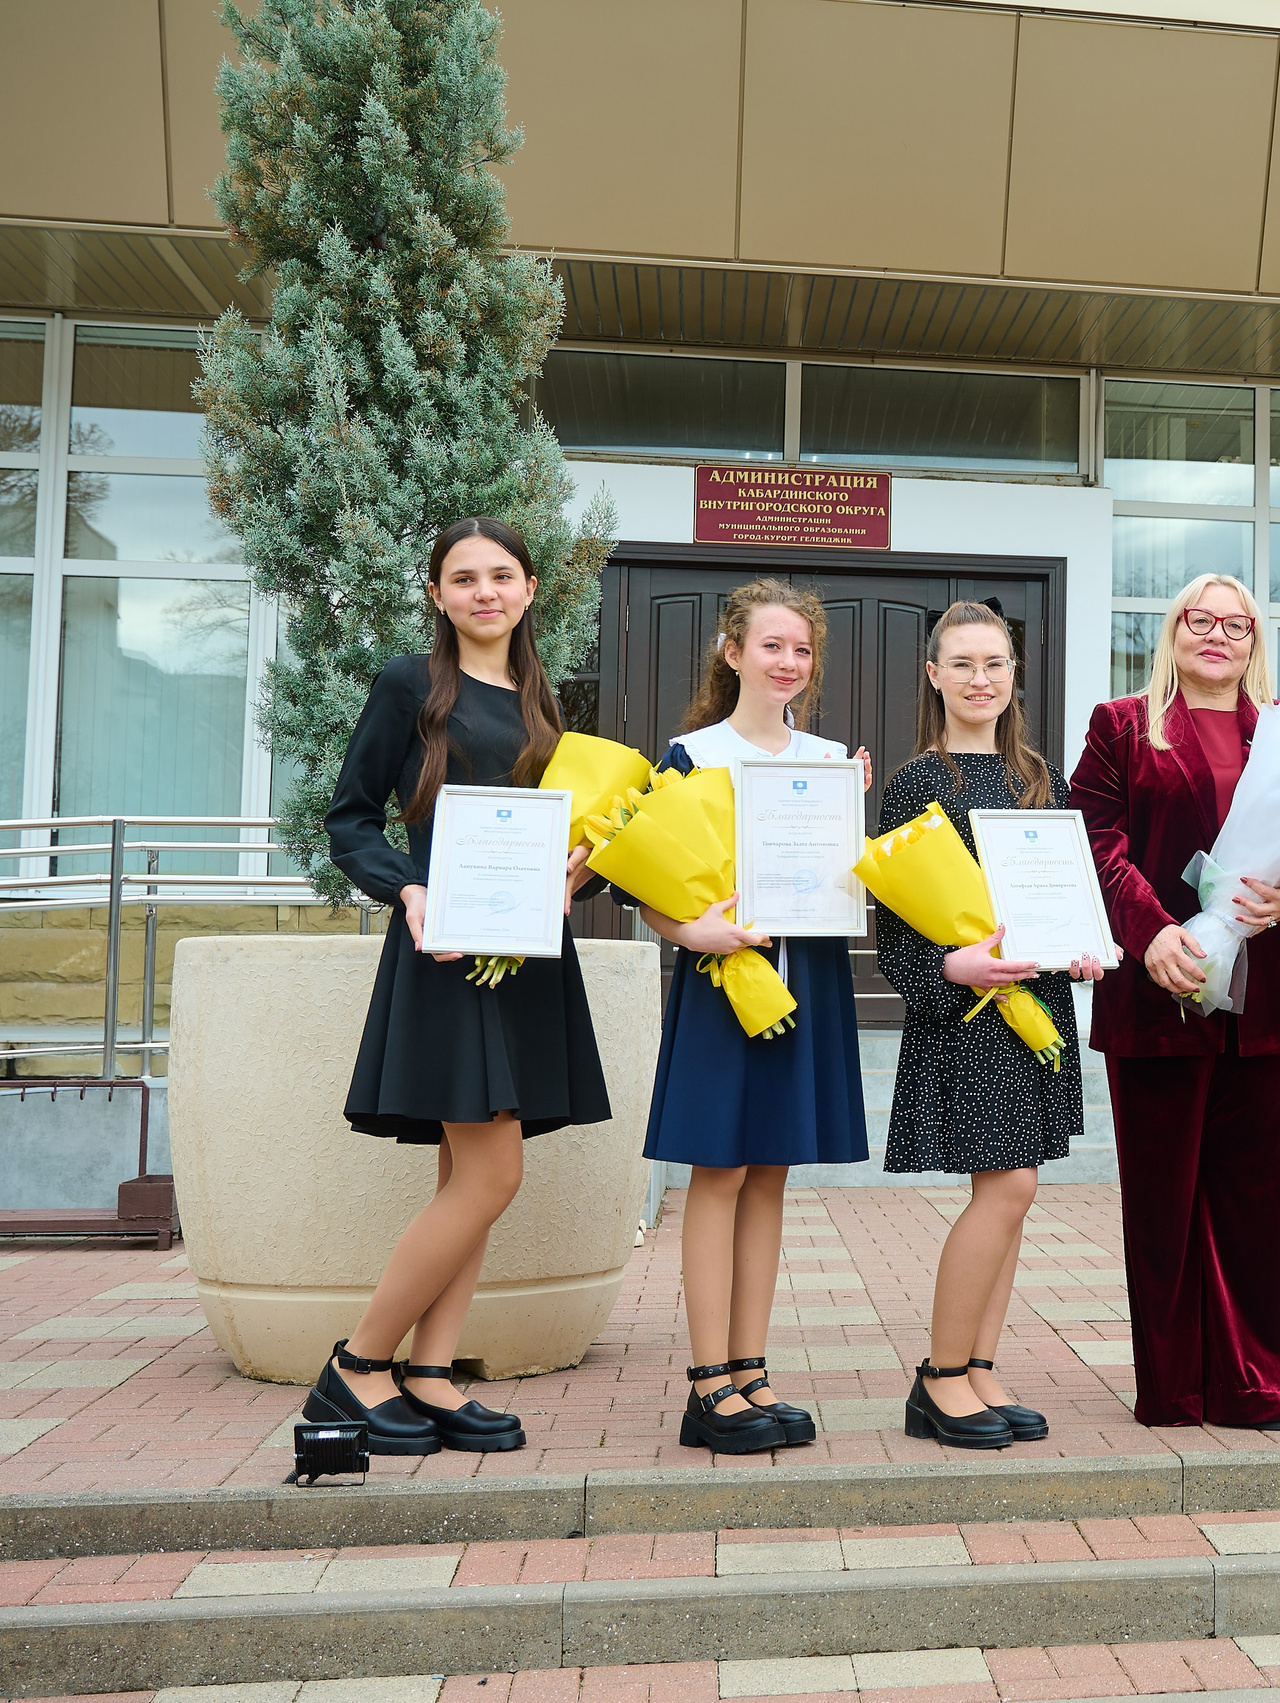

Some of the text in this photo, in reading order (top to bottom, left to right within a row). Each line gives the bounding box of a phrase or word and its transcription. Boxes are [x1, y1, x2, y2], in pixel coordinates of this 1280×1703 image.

[708, 469, 878, 490] АДМИНИСТРАЦИЯ
[738, 488, 849, 502] КАБАРДИНСКОГО
[699, 500, 886, 517] ВНУТРИГОРОДСКОГО ОКРУГА
[755, 515, 831, 525] АДМИНИСТРАЦИИ
[718, 523, 867, 535] МУНИЦИПАЛЬНОГО ОБРАЗОВАНИЯ
[733, 533, 853, 544] ГОРОД-КУРОРТ ГЕЛЕНДЖИК
[757, 808, 843, 824] Благодарность
[455, 834, 546, 850] Благодарность
